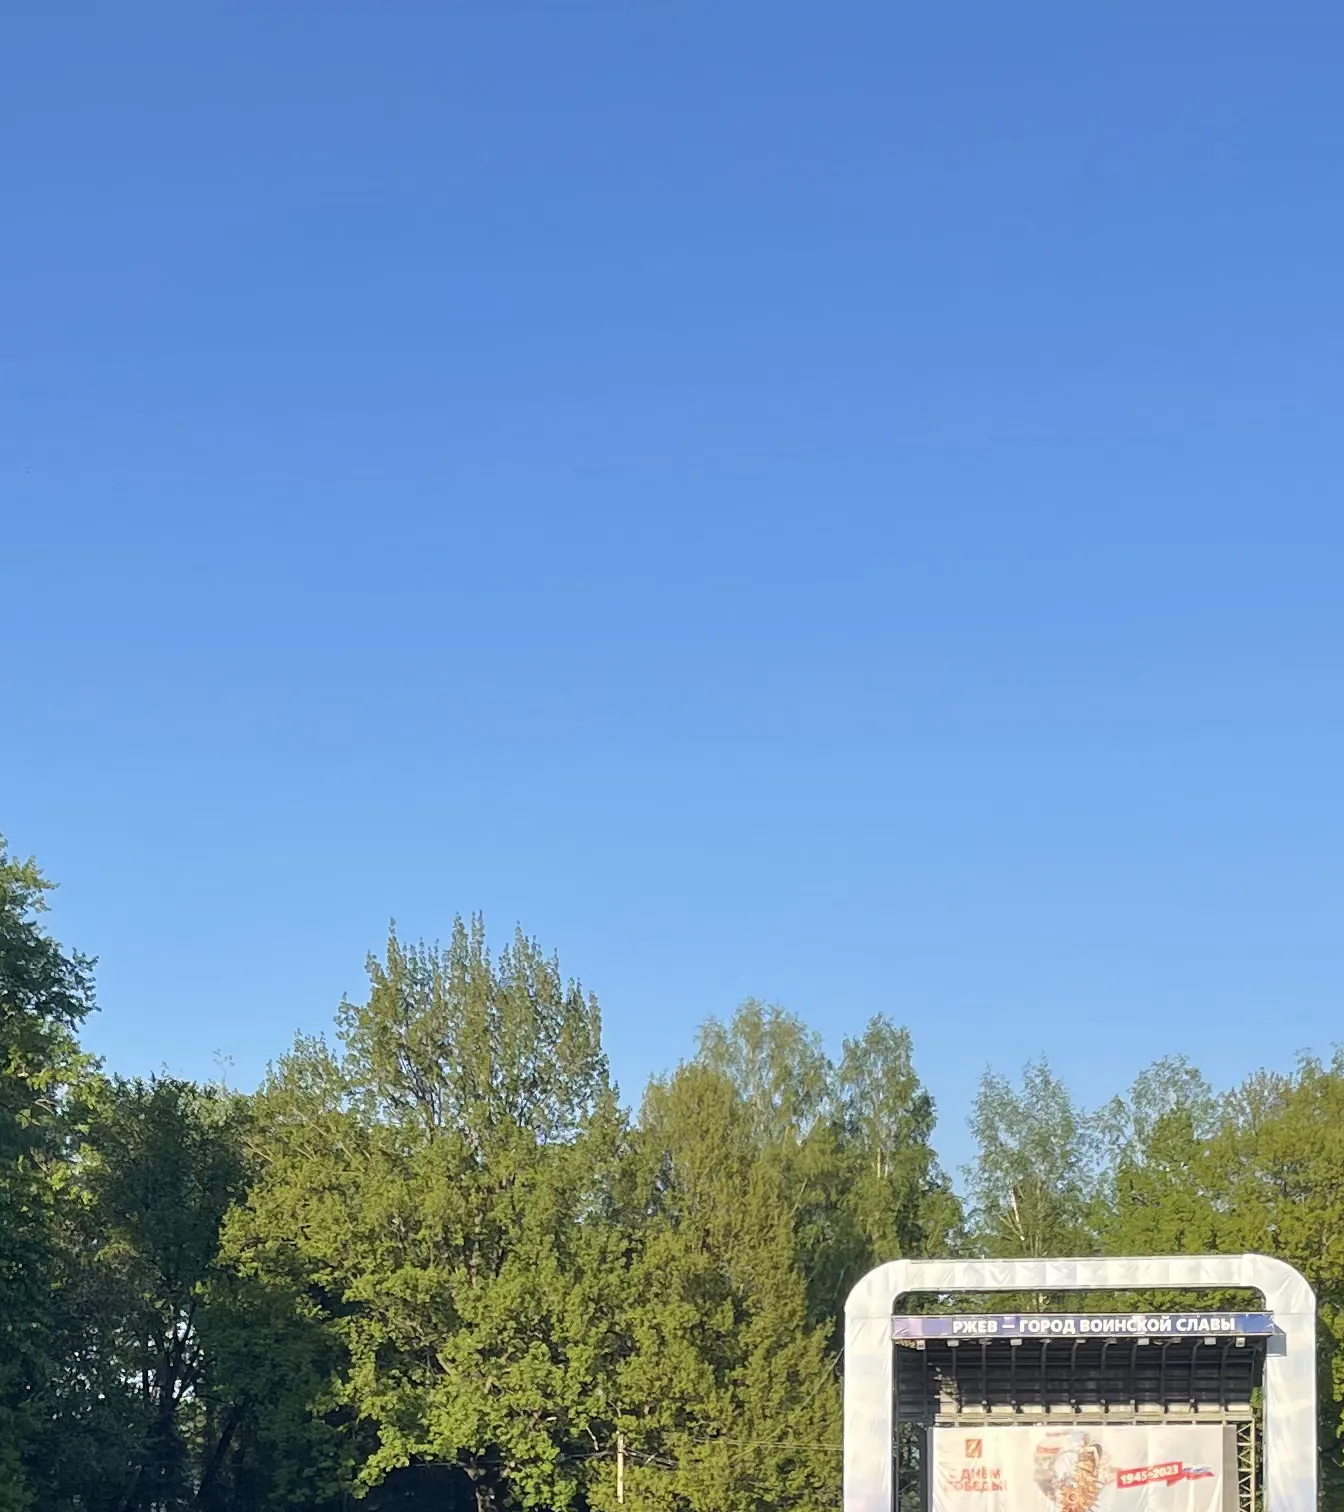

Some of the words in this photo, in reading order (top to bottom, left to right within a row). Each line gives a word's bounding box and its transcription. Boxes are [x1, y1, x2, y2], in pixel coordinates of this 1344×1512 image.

[952, 1320, 998, 1334] РЖЕВ
[1019, 1319, 1076, 1335] ГОРОД
[1079, 1315, 1172, 1333] ВОИНСКОЙ
[1176, 1318, 1236, 1332] СЛАВЫ
